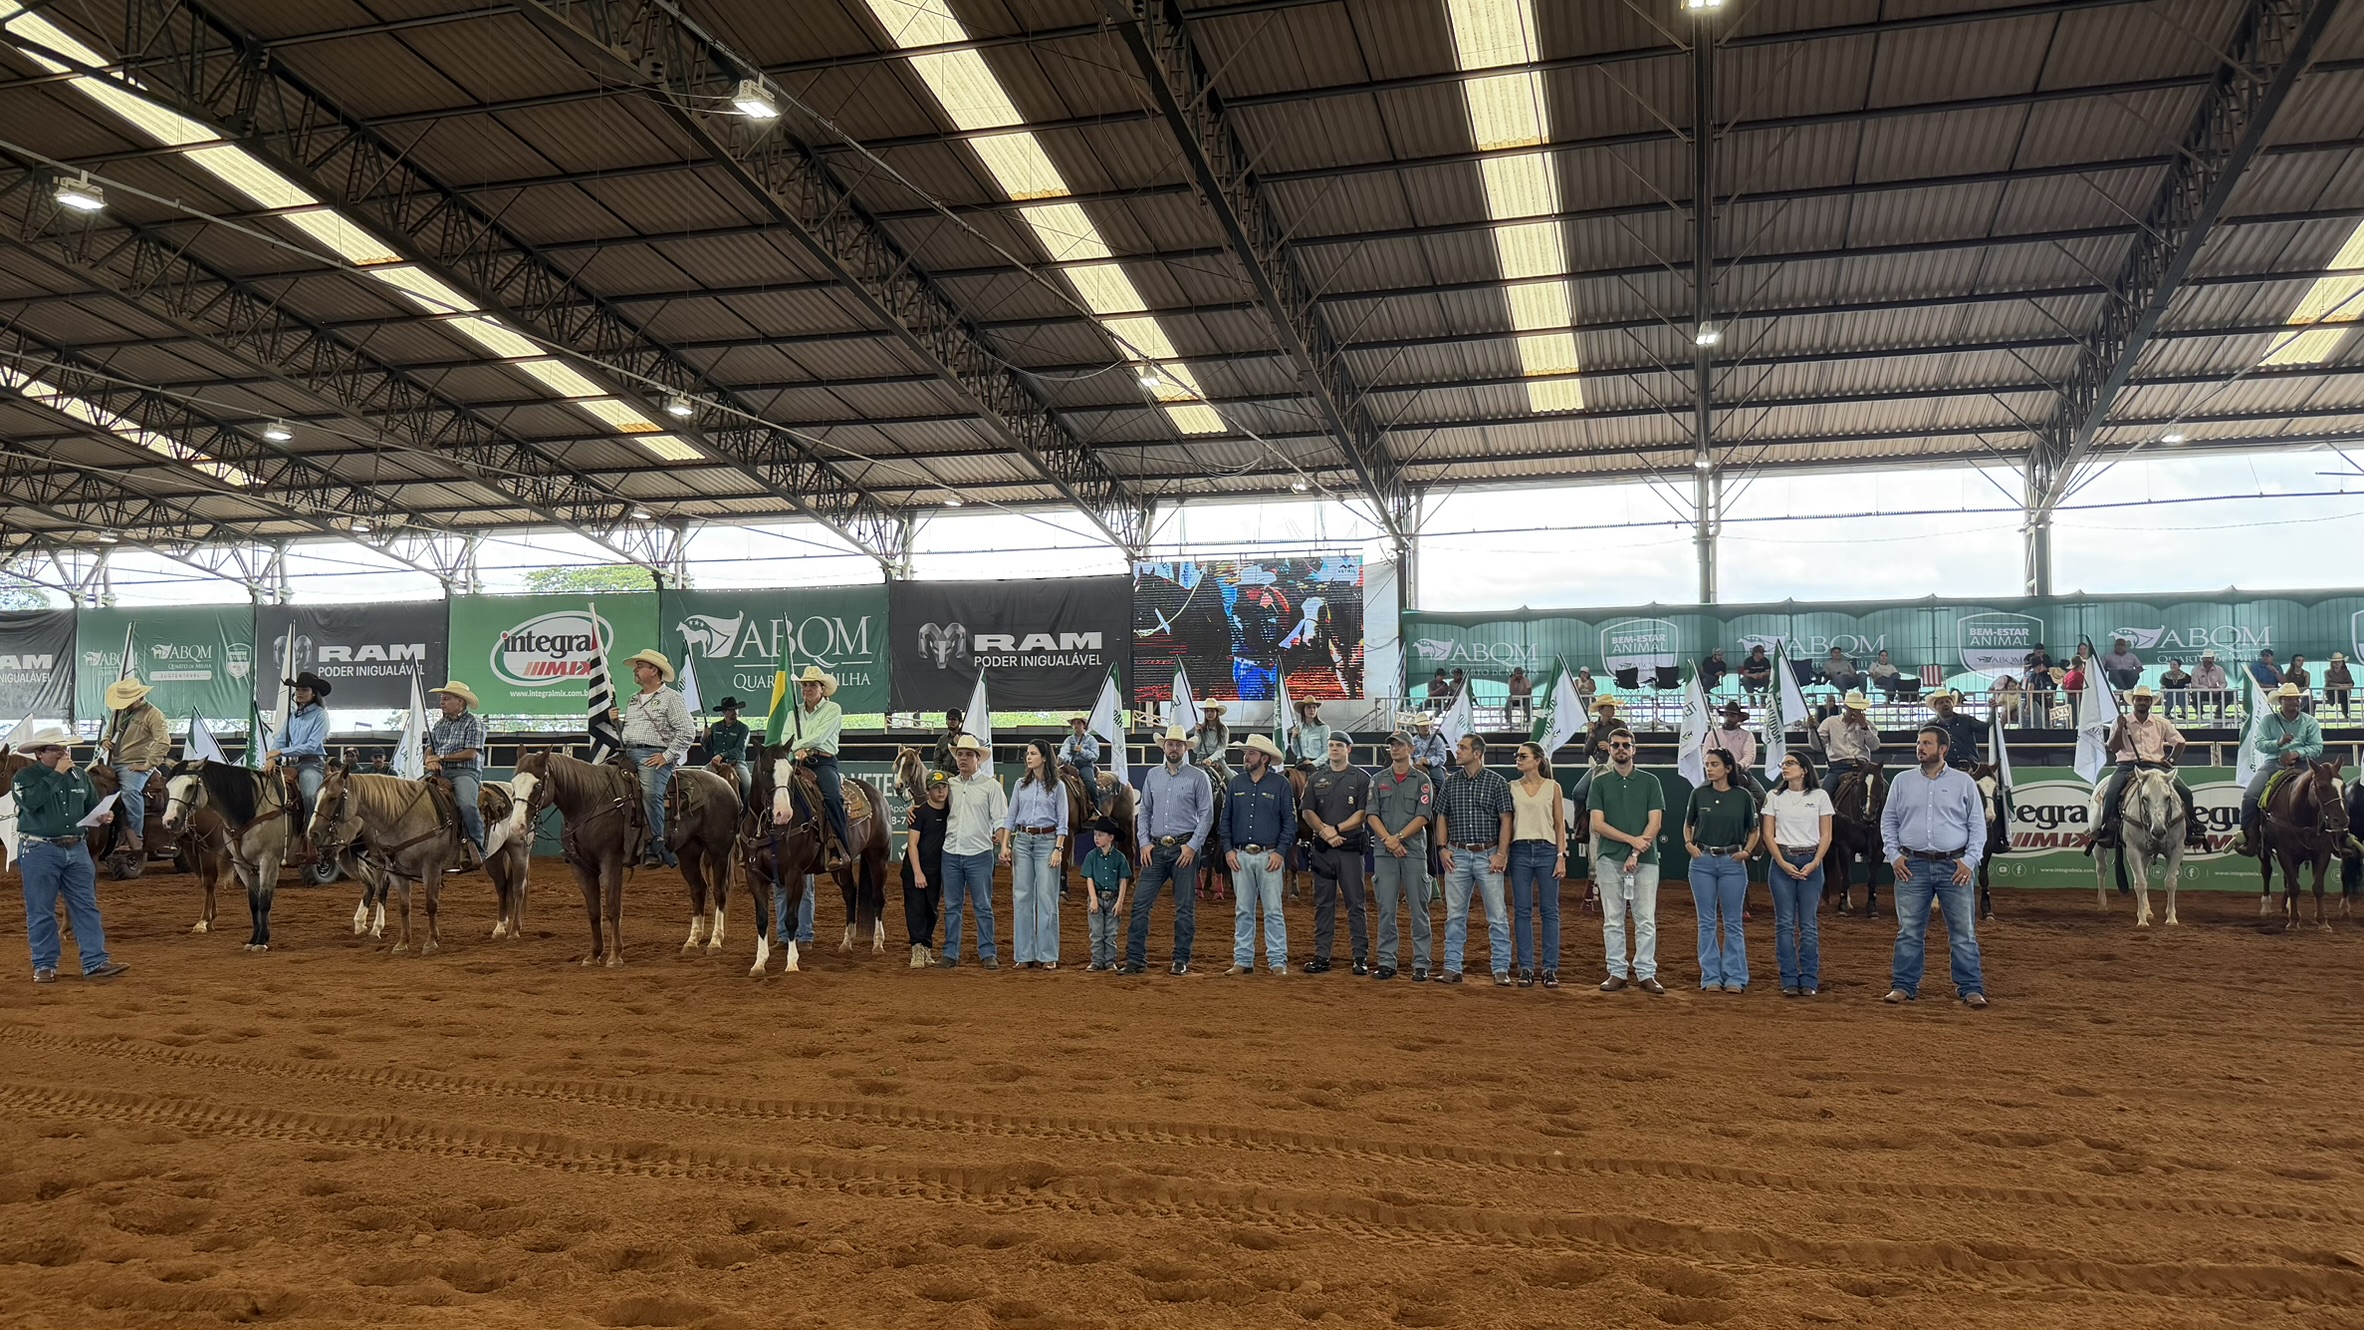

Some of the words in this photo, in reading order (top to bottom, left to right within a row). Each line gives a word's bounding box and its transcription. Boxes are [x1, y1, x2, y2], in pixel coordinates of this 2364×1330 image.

[1611, 633, 1666, 645] BEM-ESTAR
[1969, 627, 2030, 636] BEM-ESTAR
[2157, 626, 2273, 652] ABQM
[503, 631, 592, 659] integra
[734, 616, 872, 668] ABQM
[974, 631, 1103, 652] RAM
[1612, 642, 1666, 653] ANIMAL
[1785, 634, 1888, 658] ABQM
[1970, 636, 2031, 646] ANIMAL
[169, 645, 212, 662] ABQM
[318, 643, 426, 662] RAM
[974, 655, 1018, 667] PODER
[1020, 652, 1103, 667] INIGUALÁVEL
[1451, 642, 1539, 667] ABQM
[0, 654, 53, 670] AM
[0, 671, 52, 683] NIGUALÁVEL
[318, 666, 355, 677] PODER
[733, 673, 776, 692] QUAR
[836, 672, 871, 686] ILHA
[509, 689, 589, 699] www.integralmix.com.b
